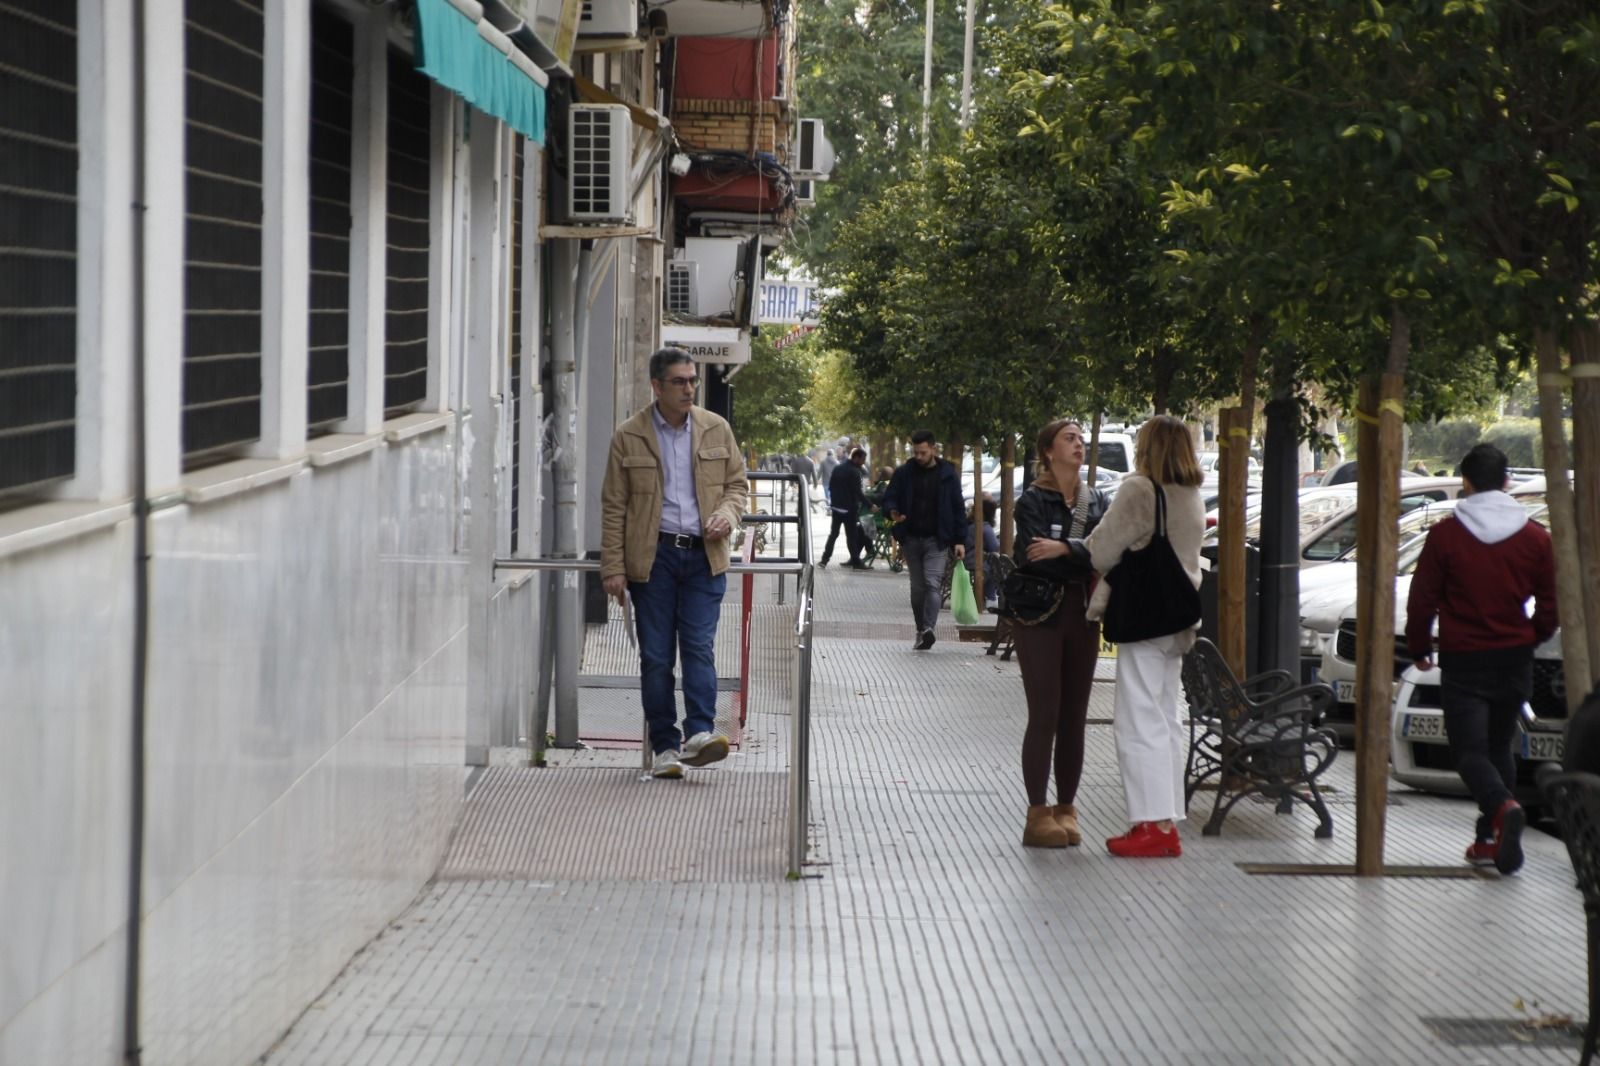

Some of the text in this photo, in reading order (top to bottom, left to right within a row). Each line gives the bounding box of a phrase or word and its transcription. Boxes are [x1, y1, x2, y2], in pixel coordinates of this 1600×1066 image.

[688, 346, 729, 357] ARAJE
[1340, 684, 1357, 700] 27
[1530, 736, 1564, 758] 9276
